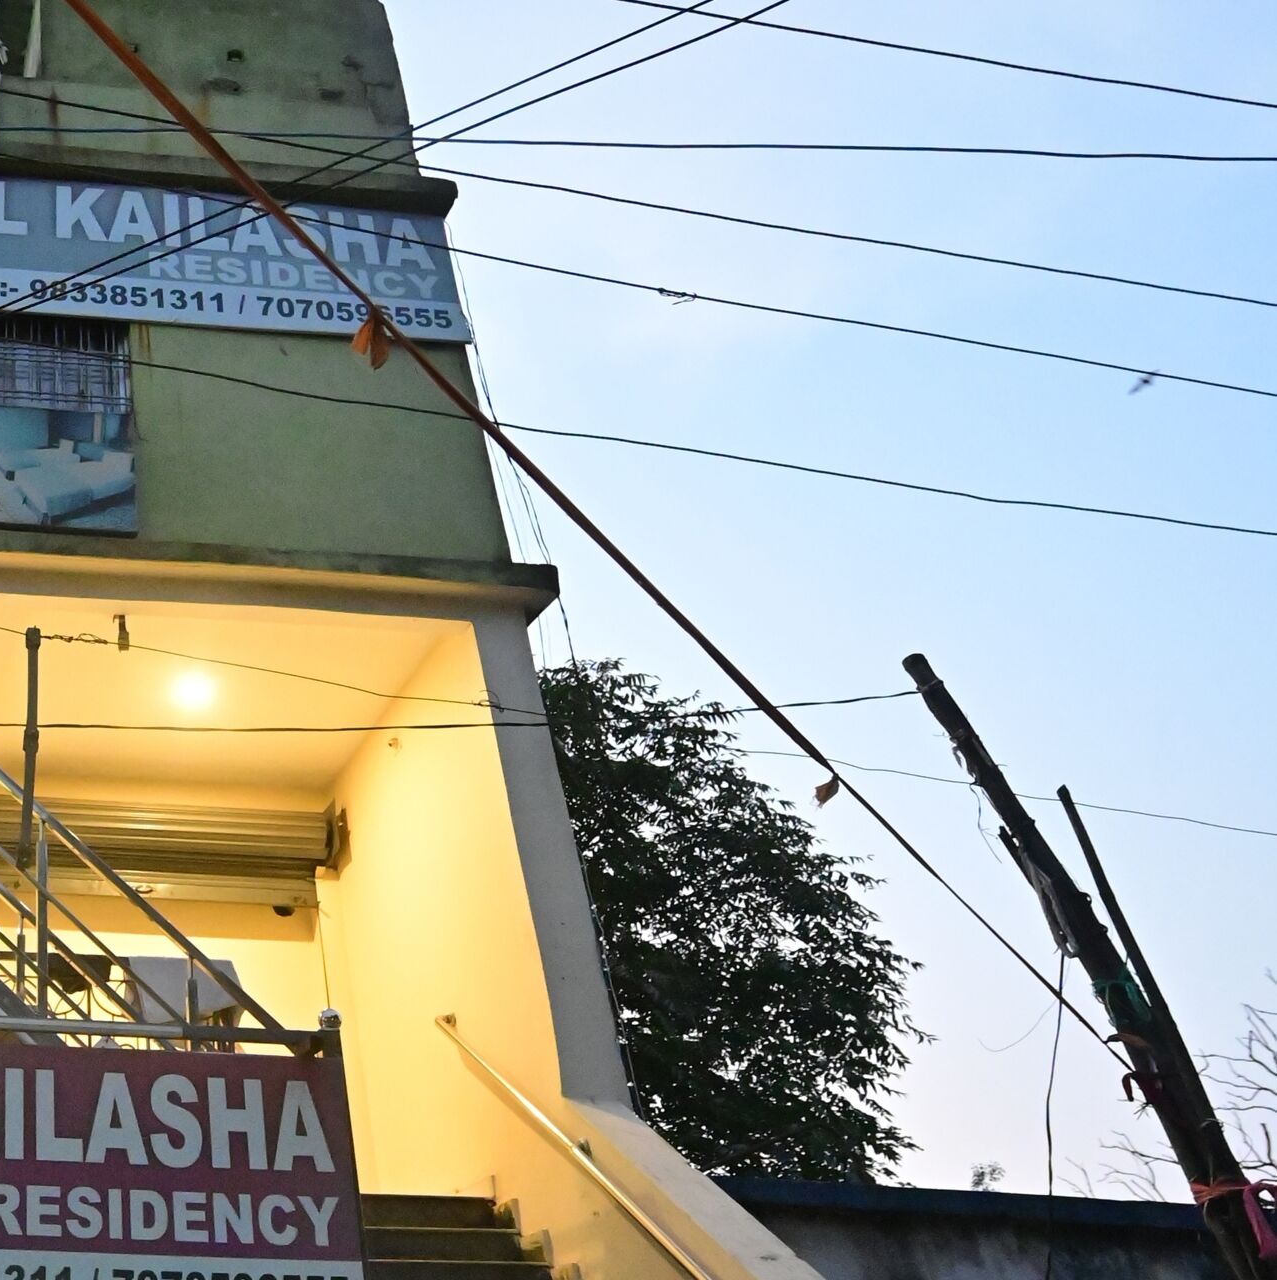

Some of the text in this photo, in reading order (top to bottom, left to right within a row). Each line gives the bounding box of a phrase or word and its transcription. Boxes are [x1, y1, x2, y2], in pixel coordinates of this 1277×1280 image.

[56, 186, 435, 270] KAILASHA
[29, 279, 224, 312] 9833851311
[149, 250, 438, 299] RESIDENCY
